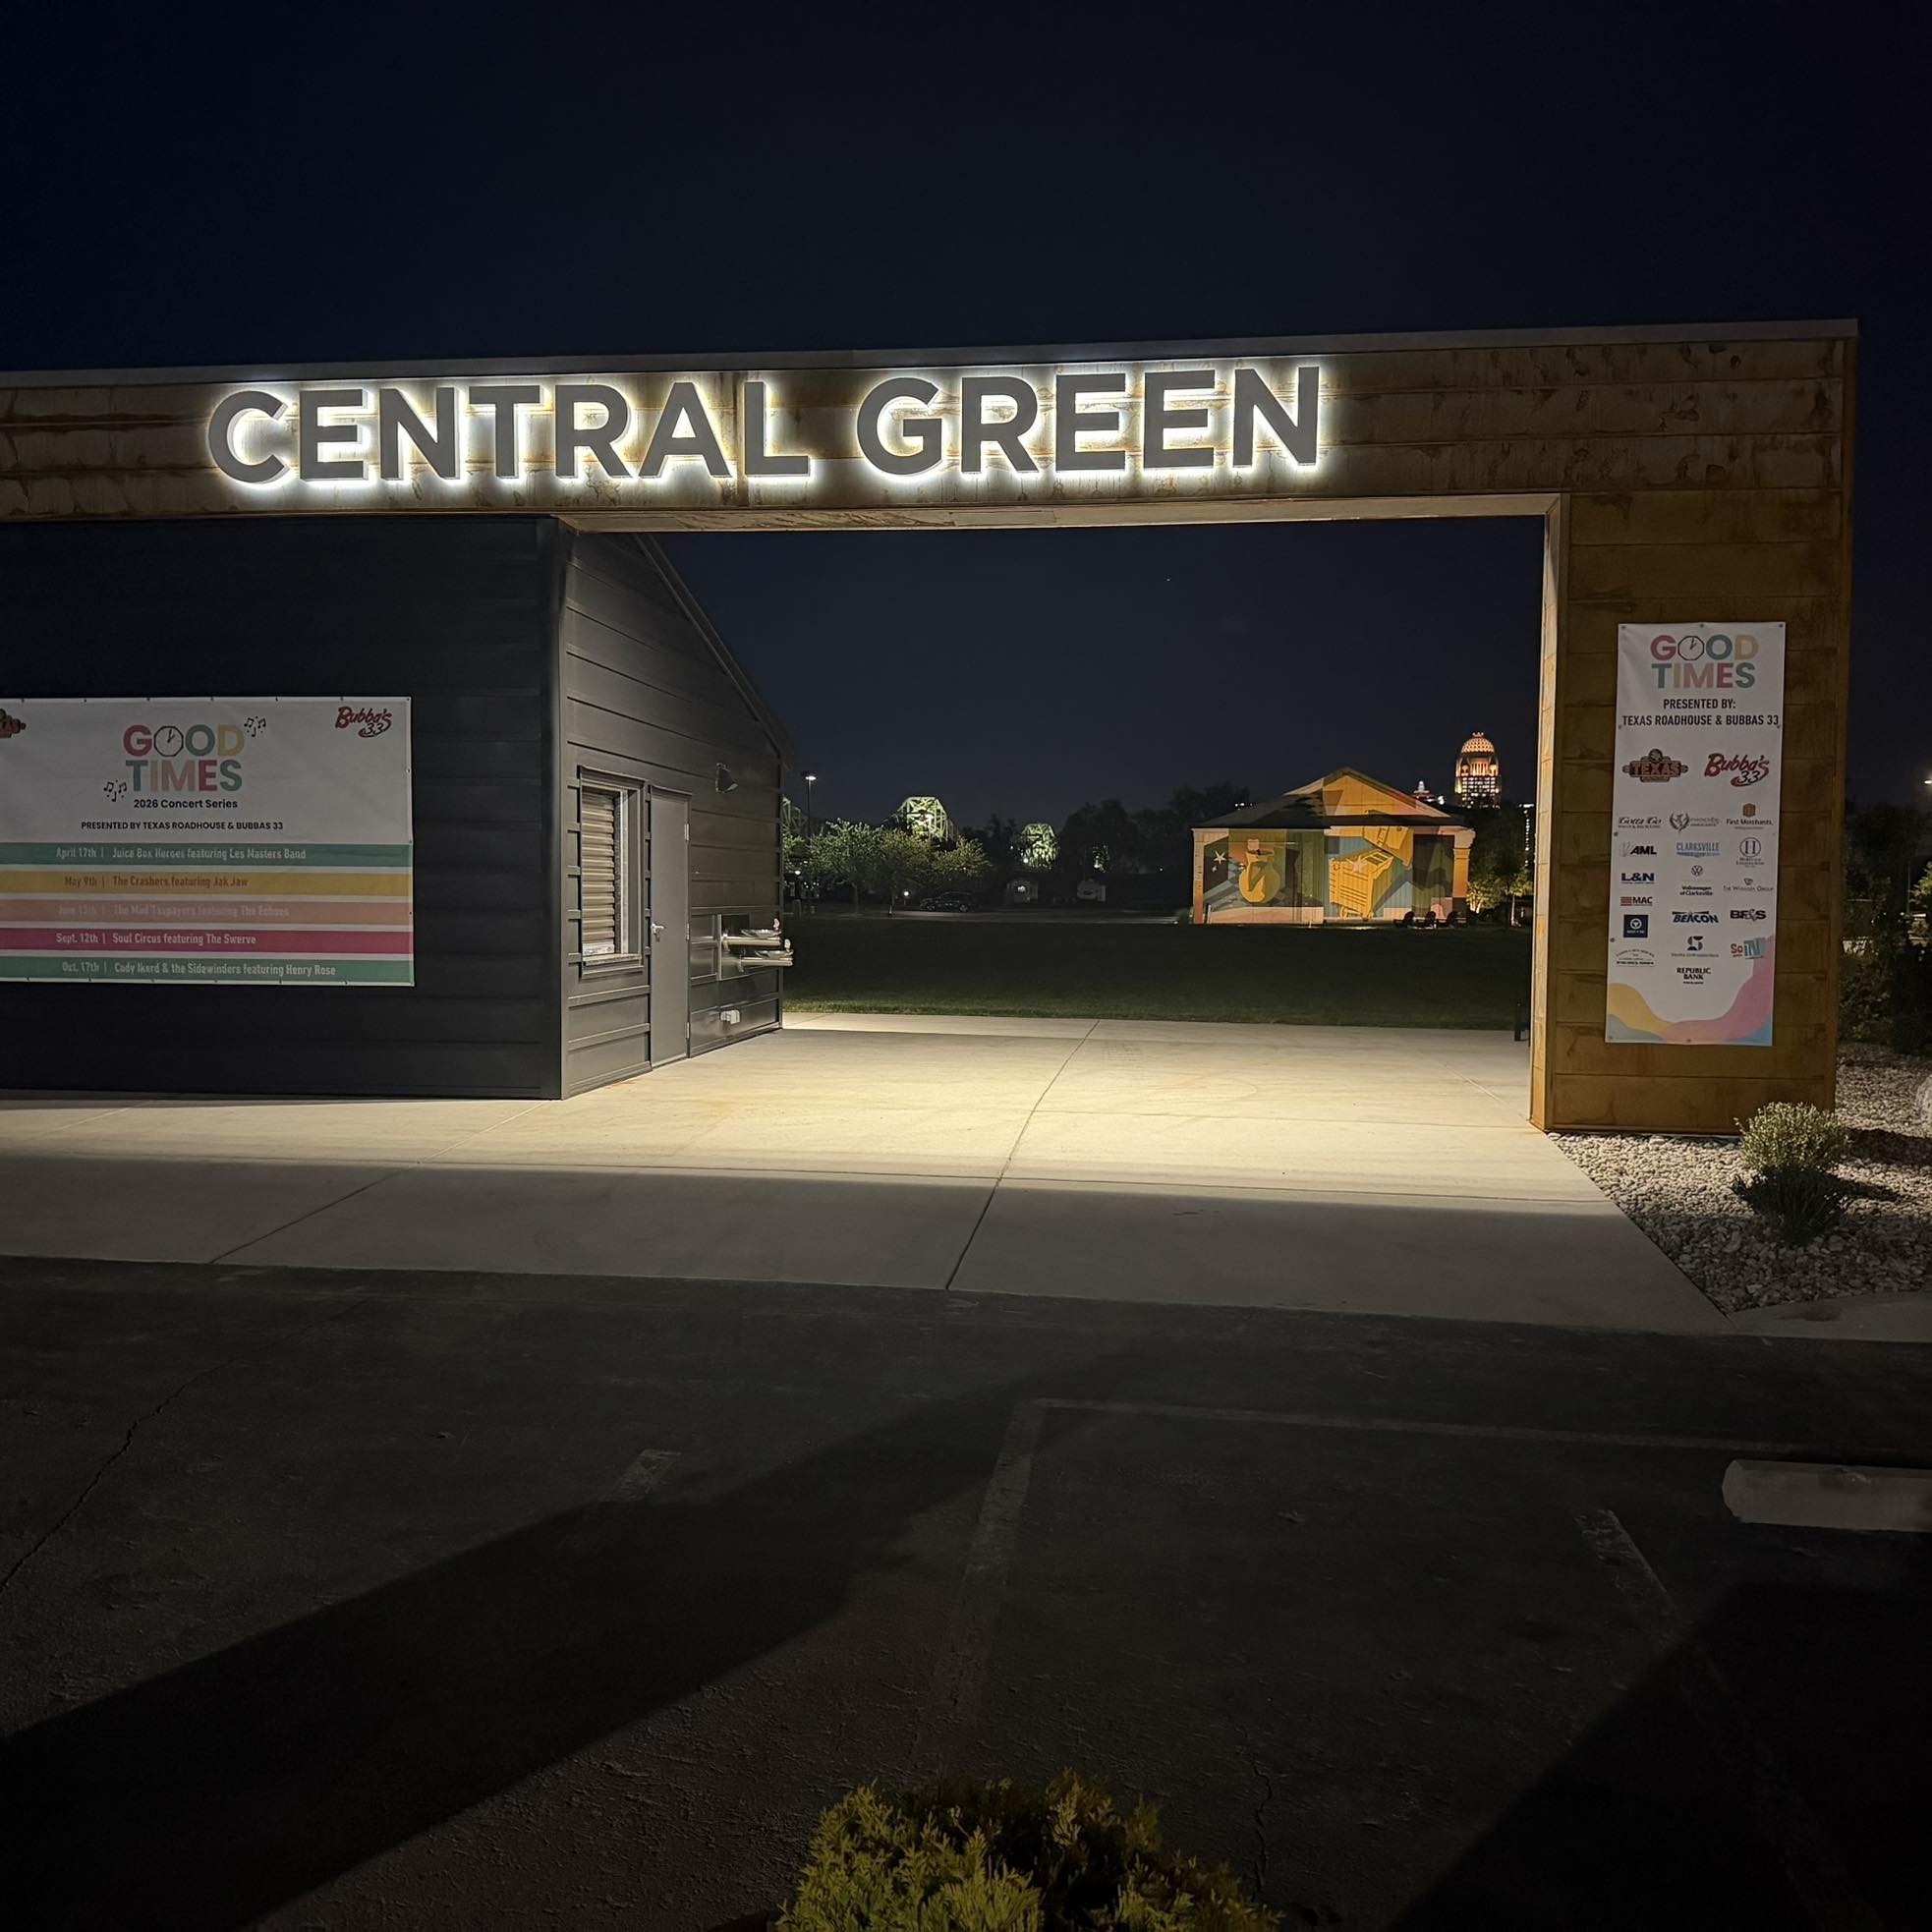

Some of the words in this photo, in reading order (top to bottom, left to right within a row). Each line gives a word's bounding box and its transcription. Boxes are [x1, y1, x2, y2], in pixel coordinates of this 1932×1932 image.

[206, 380, 811, 483] CENTRAL
[856, 365, 1320, 477] GREEN
[1651, 661, 1756, 689] TIMES
[1663, 698, 1719, 710] PRESENTED
[1721, 698, 1736, 710] BY:
[334, 706, 393, 729] Bubba's
[1621, 714, 1653, 726] TEXAS
[1655, 714, 1712, 726] ROADHOUSE
[1715, 714, 1723, 725] &
[1726, 714, 1764, 725] BUBBAS
[1767, 714, 1780, 725] 33
[365, 722, 385, 736] 33
[1632, 762, 1681, 776] TEXAS
[1703, 753, 1770, 777] Bubba's
[125, 759, 244, 792] TIMES
[1736, 770, 1760, 784] 33
[134, 799, 158, 809] 2026
[160, 799, 203, 809] Concert
[204, 799, 238, 809] Series
[81, 822, 129, 830] PRESENTED
[130, 822, 142, 830] BY
[142, 822, 171, 830] TEXAS
[172, 822, 227, 830] ROADHOUSE
[227, 822, 234, 830] &
[236, 822, 271, 830] BUBBAS
[272, 822, 284, 830] 33
[1630, 844, 1657, 855] AML
[1676, 842, 1720, 852] CLARKSVILLE
[55, 848, 76, 860] April
[79, 848, 96, 858] 17th
[112, 848, 134, 858] Juice
[137, 848, 153, 858] Box
[187, 848, 227, 861] featuring
[229, 848, 245, 859] Les
[247, 848, 282, 859] Masters
[284, 848, 307, 859] Band
[64, 877, 82, 888] May
[83, 876, 97, 886] 9th
[113, 876, 129, 886] The
[130, 876, 170, 886] Crashers
[171, 877, 210, 888] featuring
[213, 877, 229, 886] Jak
[230, 877, 249, 886] Jaw
[1620, 872, 1655, 881] L&N
[240, 905, 256, 916] The
[1673, 913, 1719, 923] BEACON
[55, 933, 78, 944] Sept.
[81, 933, 98, 943] 12th
[112, 934, 133, 943] Soul
[135, 934, 161, 943] Circus
[163, 934, 203, 946] featuring
[206, 934, 221, 943] The
[223, 934, 256, 943] Swerve
[62, 961, 79, 972] Oct.
[81, 961, 99, 972] 17th
[114, 963, 135, 975] Cody
[137, 963, 160, 974] Ikerd
[162, 963, 169, 974] &
[171, 963, 186, 974] the
[188, 963, 242, 975] Sidewinders
[243, 964, 283, 977] featuring
[286, 964, 312, 977] Henry
[313, 965, 336, 976] Rose
